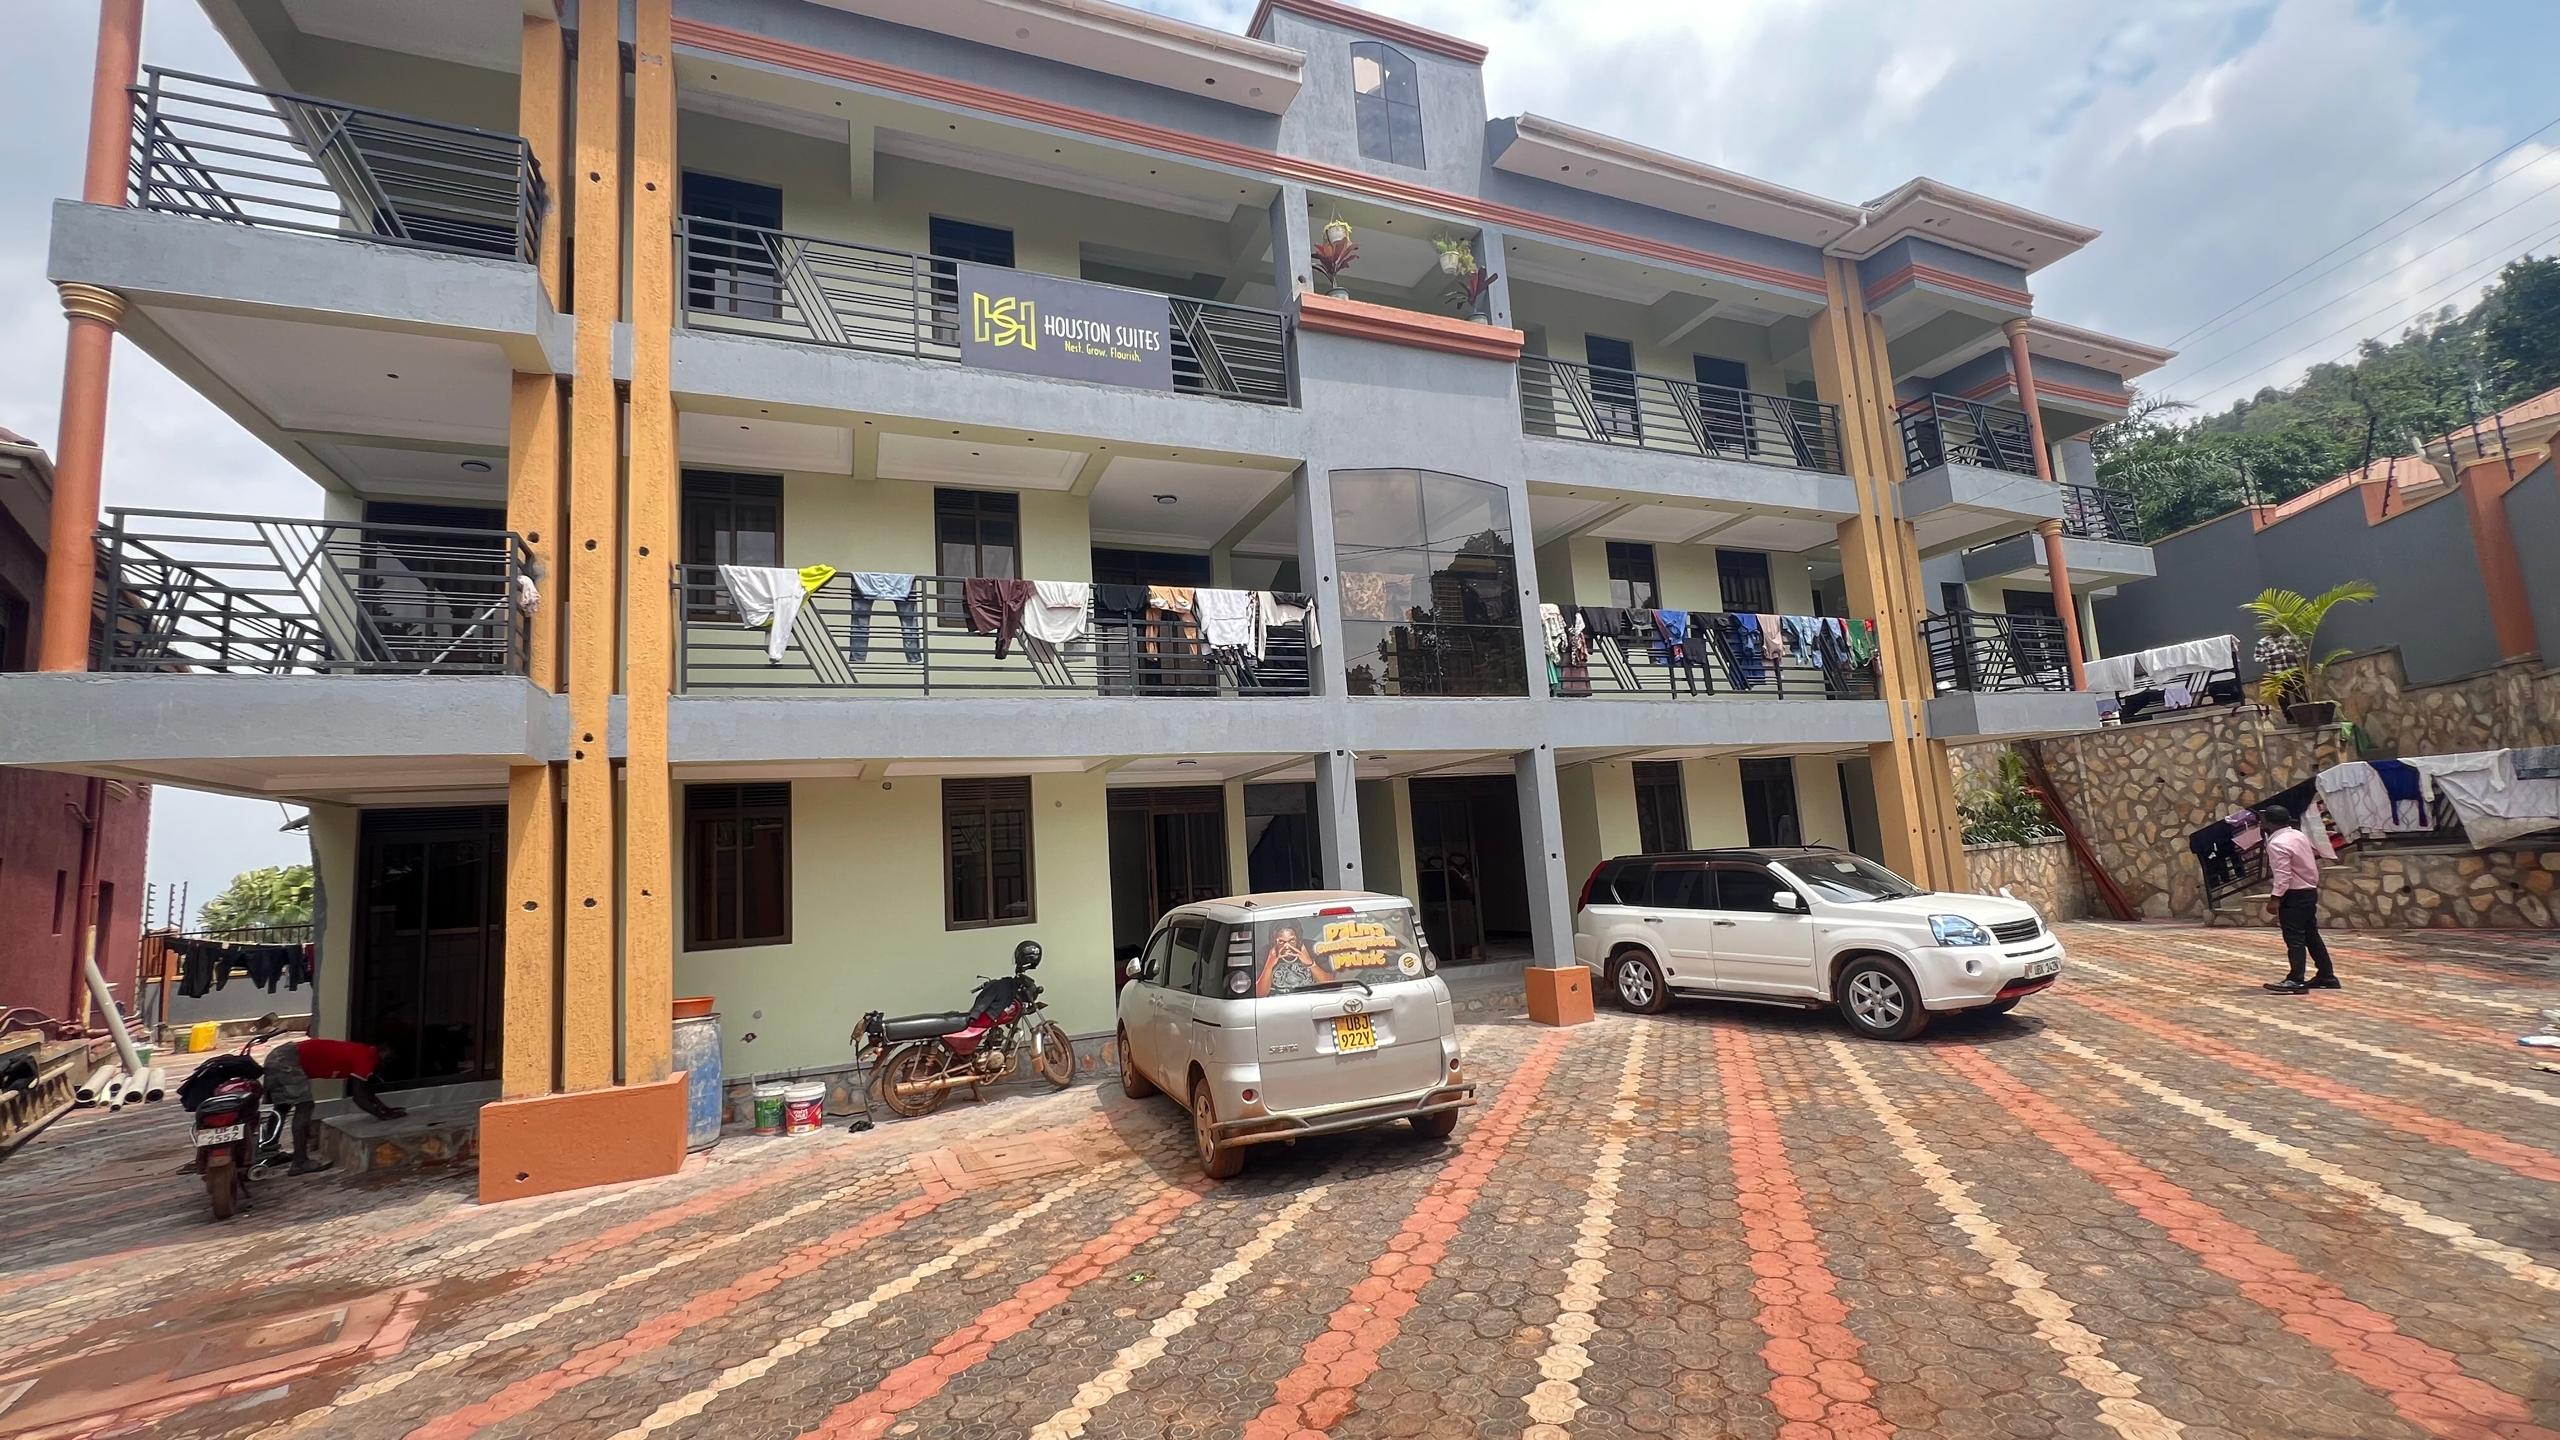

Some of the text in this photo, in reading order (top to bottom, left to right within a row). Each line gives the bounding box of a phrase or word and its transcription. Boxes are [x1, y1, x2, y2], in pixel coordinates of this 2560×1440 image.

[1044, 314, 1160, 351] HOUSTON SUITES
[1064, 340, 1142, 362] Nest. Grow. Flourish.
[1346, 1015, 1369, 1031] UBJ
[1341, 1031, 1371, 1048] 922Y
